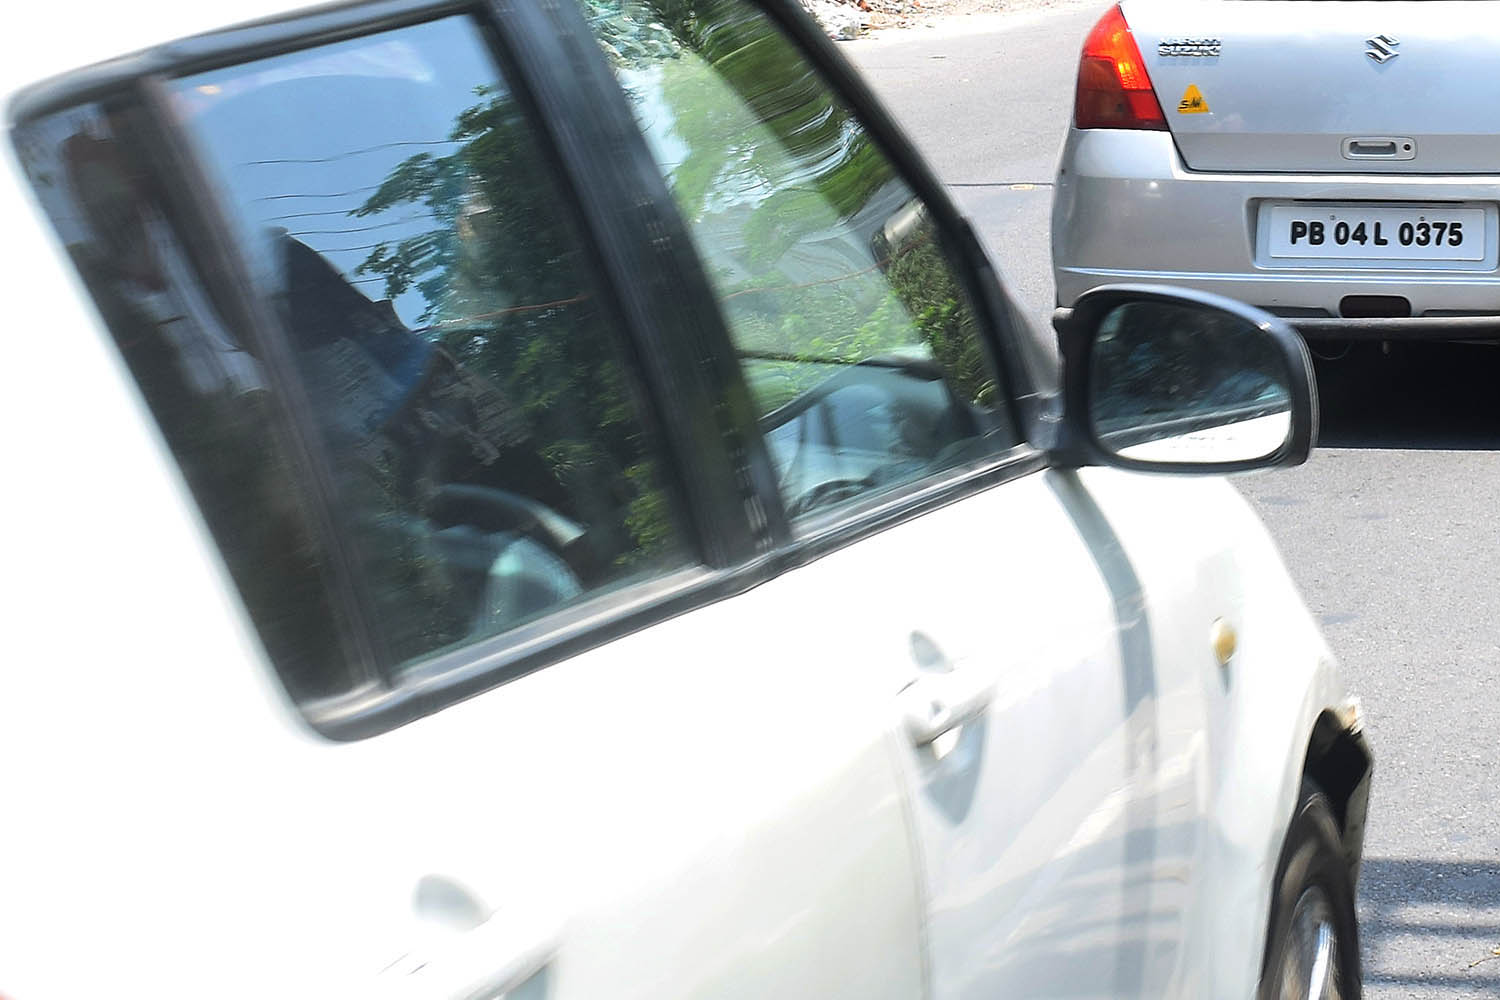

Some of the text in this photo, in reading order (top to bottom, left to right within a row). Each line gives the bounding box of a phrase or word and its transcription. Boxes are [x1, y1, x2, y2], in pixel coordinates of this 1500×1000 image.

[1290, 221, 1463, 247] PB 04 L 0375
